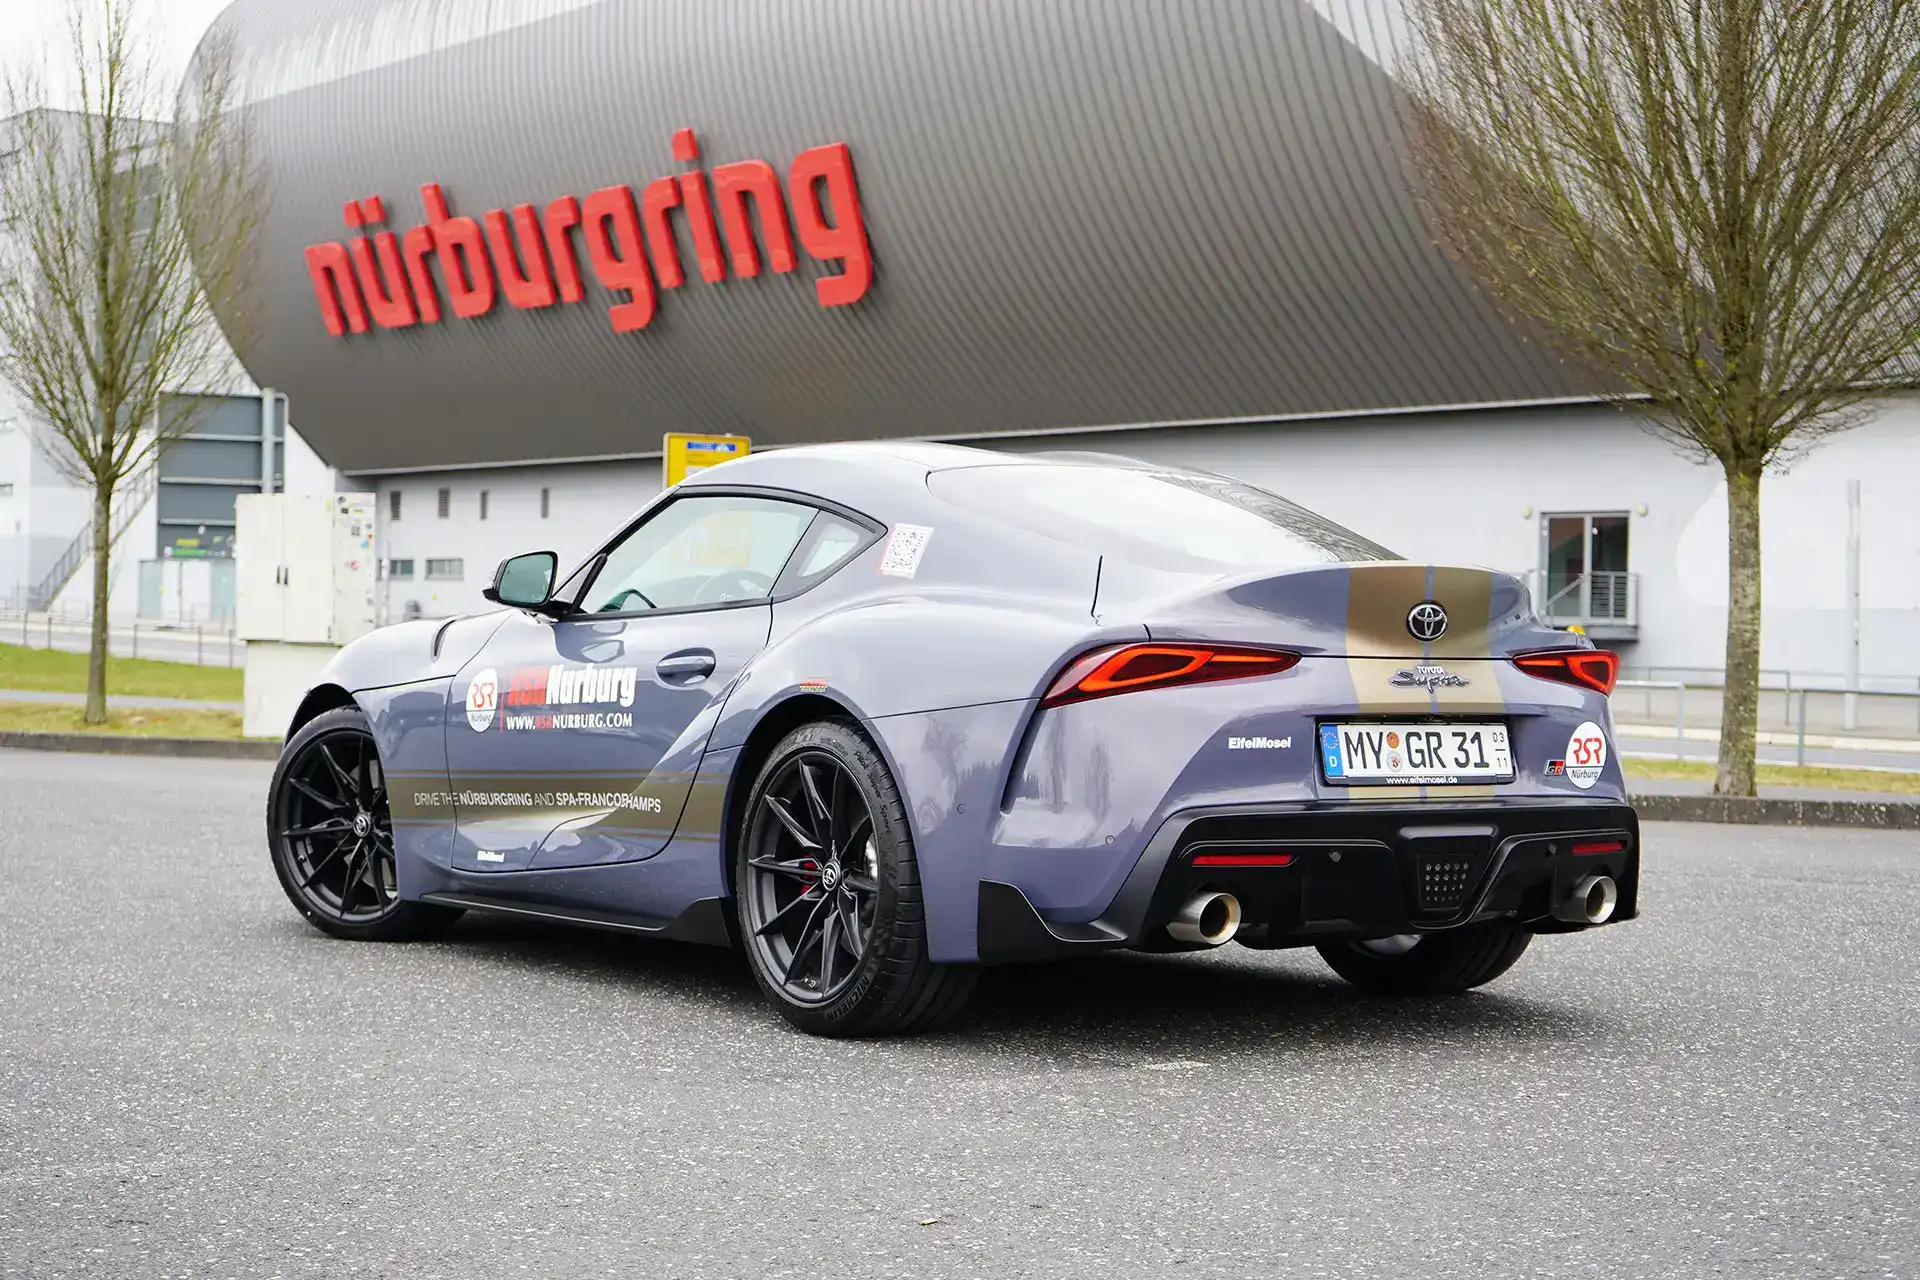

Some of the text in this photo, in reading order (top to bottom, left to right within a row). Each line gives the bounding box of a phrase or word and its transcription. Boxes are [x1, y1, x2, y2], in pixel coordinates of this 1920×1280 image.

[304, 127, 873, 336] nürburgring
[1416, 666, 1445, 674] TOYOTA
[1391, 671, 1470, 694] Supra
[1228, 736, 1292, 749] EifelMosel
[1492, 732, 1505, 743] 03
[1344, 732, 1489, 769] MY GR 31
[1573, 737, 1602, 765] RSR
[1329, 755, 1338, 768] D
[1496, 757, 1508, 768] 11
[1386, 775, 1458, 784] www.eifelmosel.de
[1571, 769, 1599, 780] Nürburg
[414, 792, 440, 806] DRIVE
[441, 793, 459, 806] THE
[460, 790, 532, 806] NÜRBURGRING
[534, 793, 555, 806] AND
